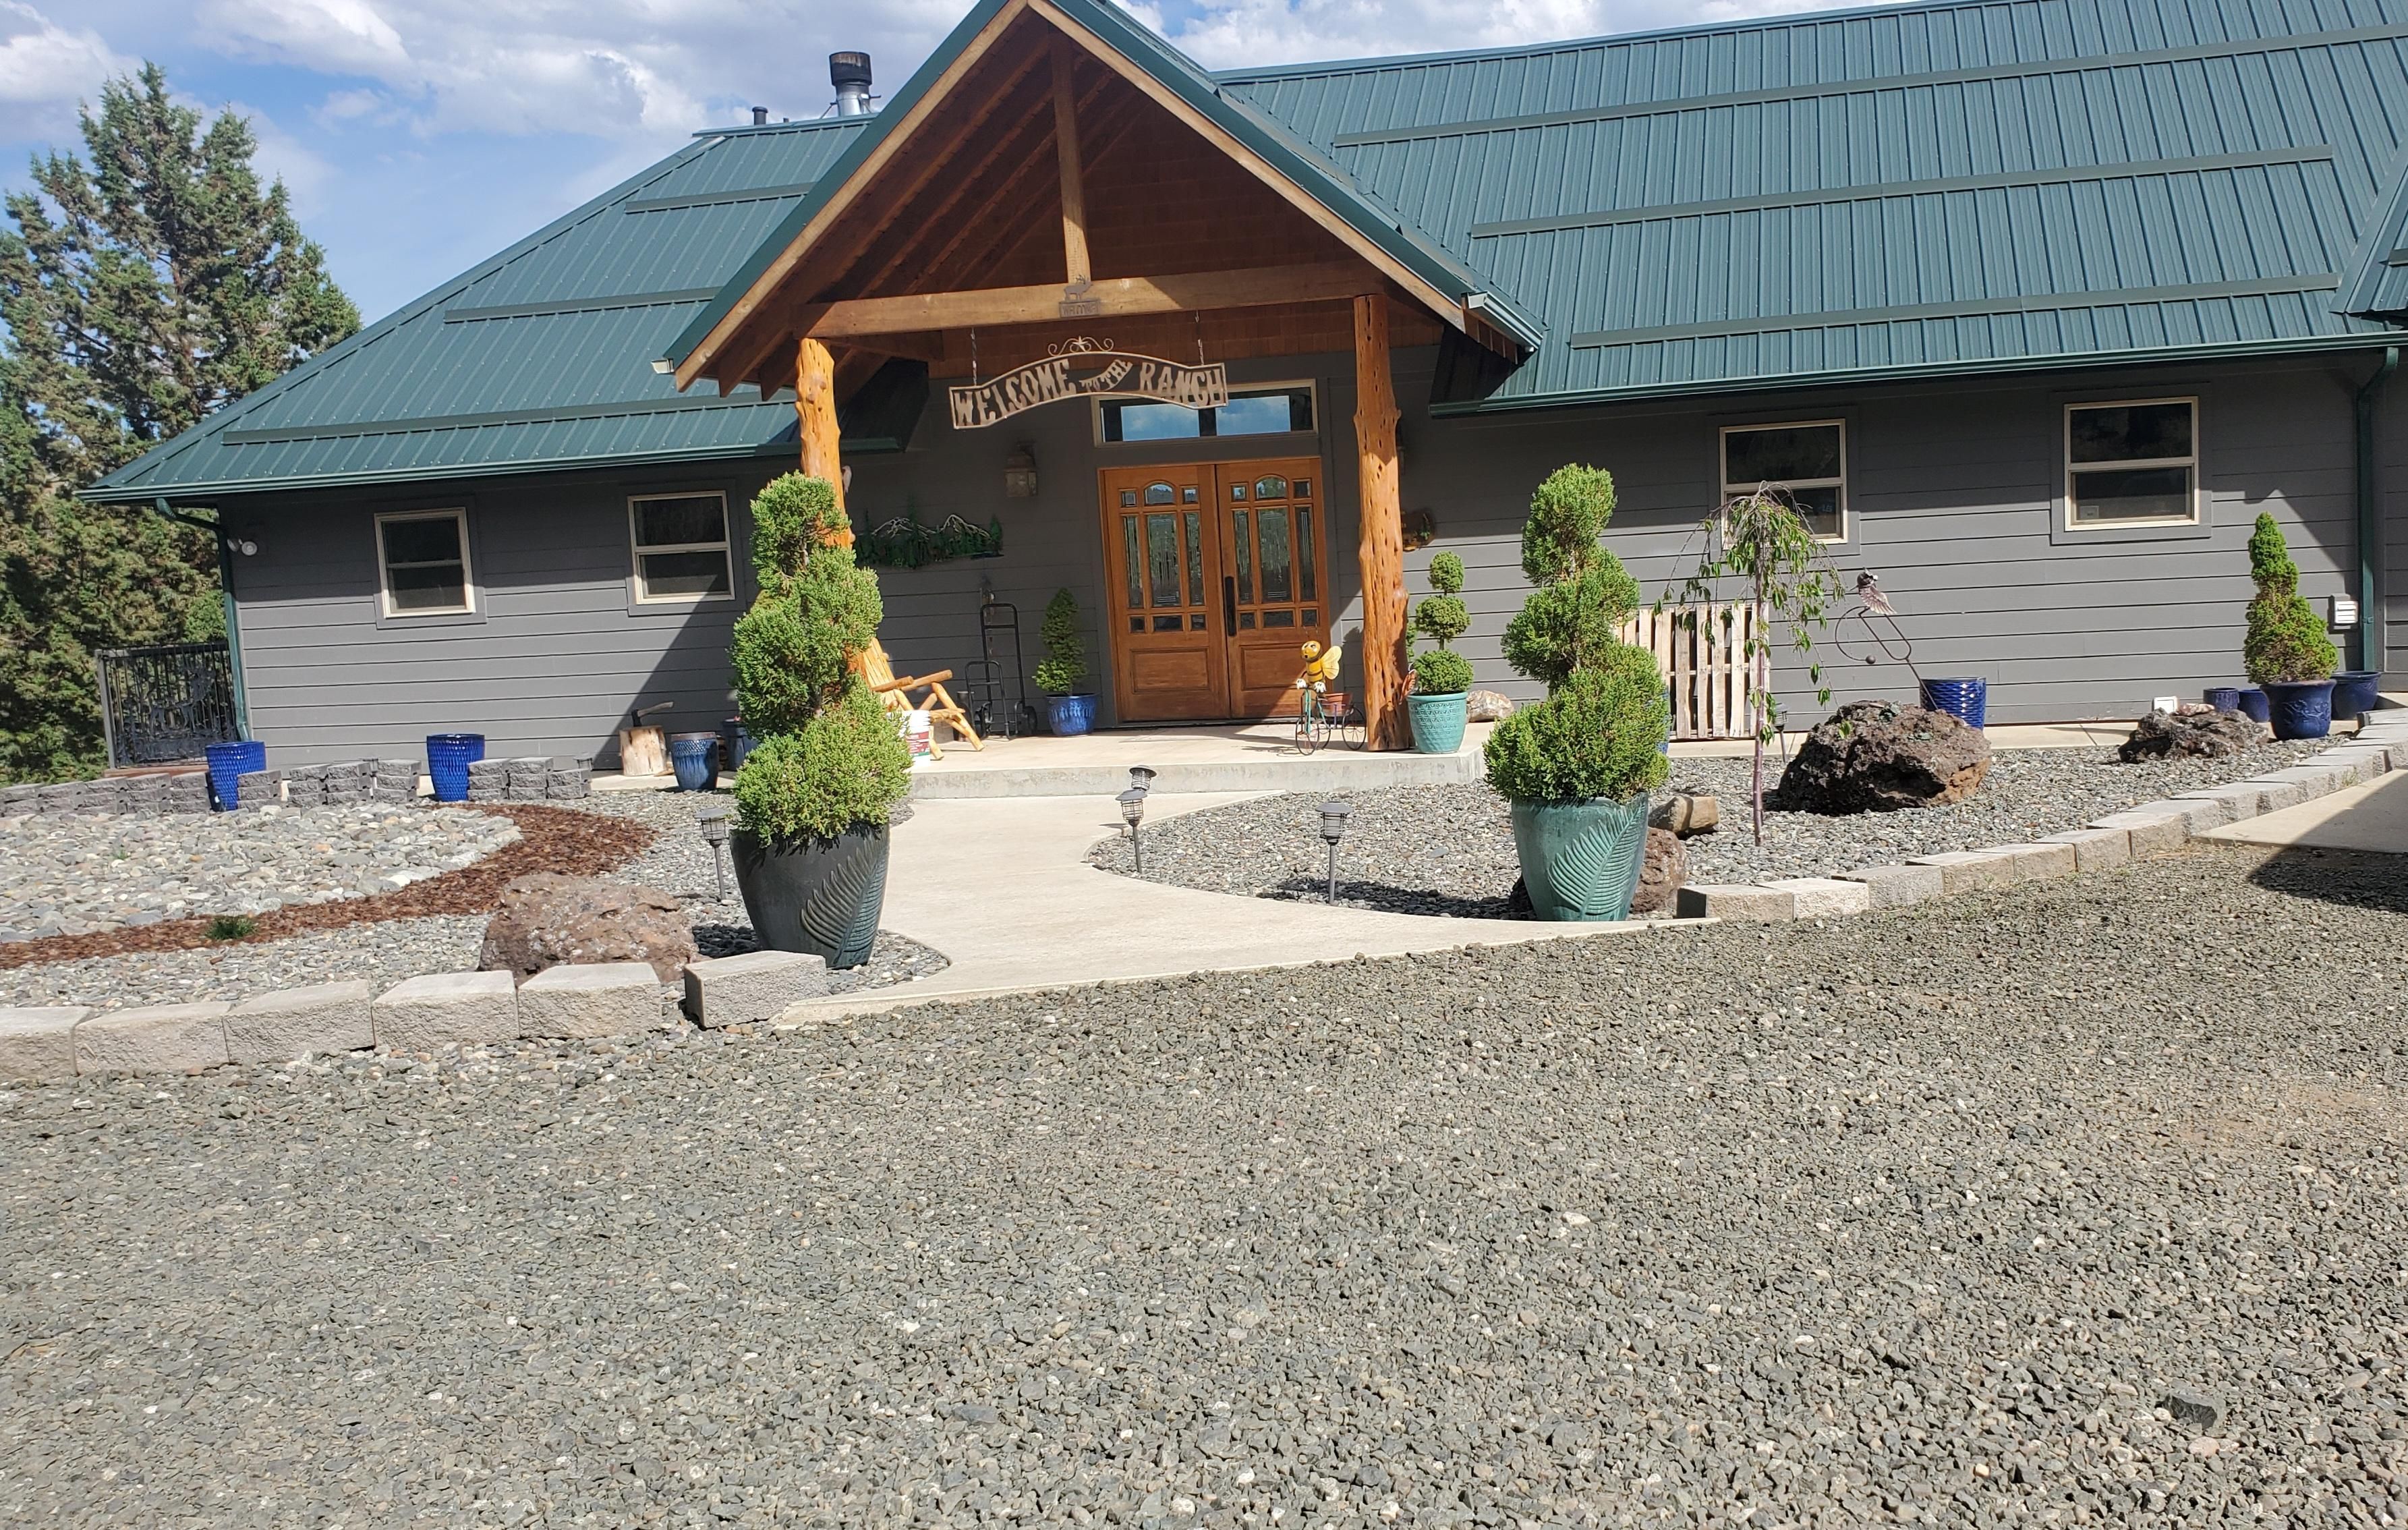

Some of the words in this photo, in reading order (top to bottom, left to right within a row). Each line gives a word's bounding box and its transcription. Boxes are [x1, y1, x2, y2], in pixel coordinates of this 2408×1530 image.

[954, 358, 1077, 426] WELCOME
[1079, 378, 1100, 393] TO
[1099, 359, 1133, 391] THE
[1139, 362, 1224, 407] RANCH
